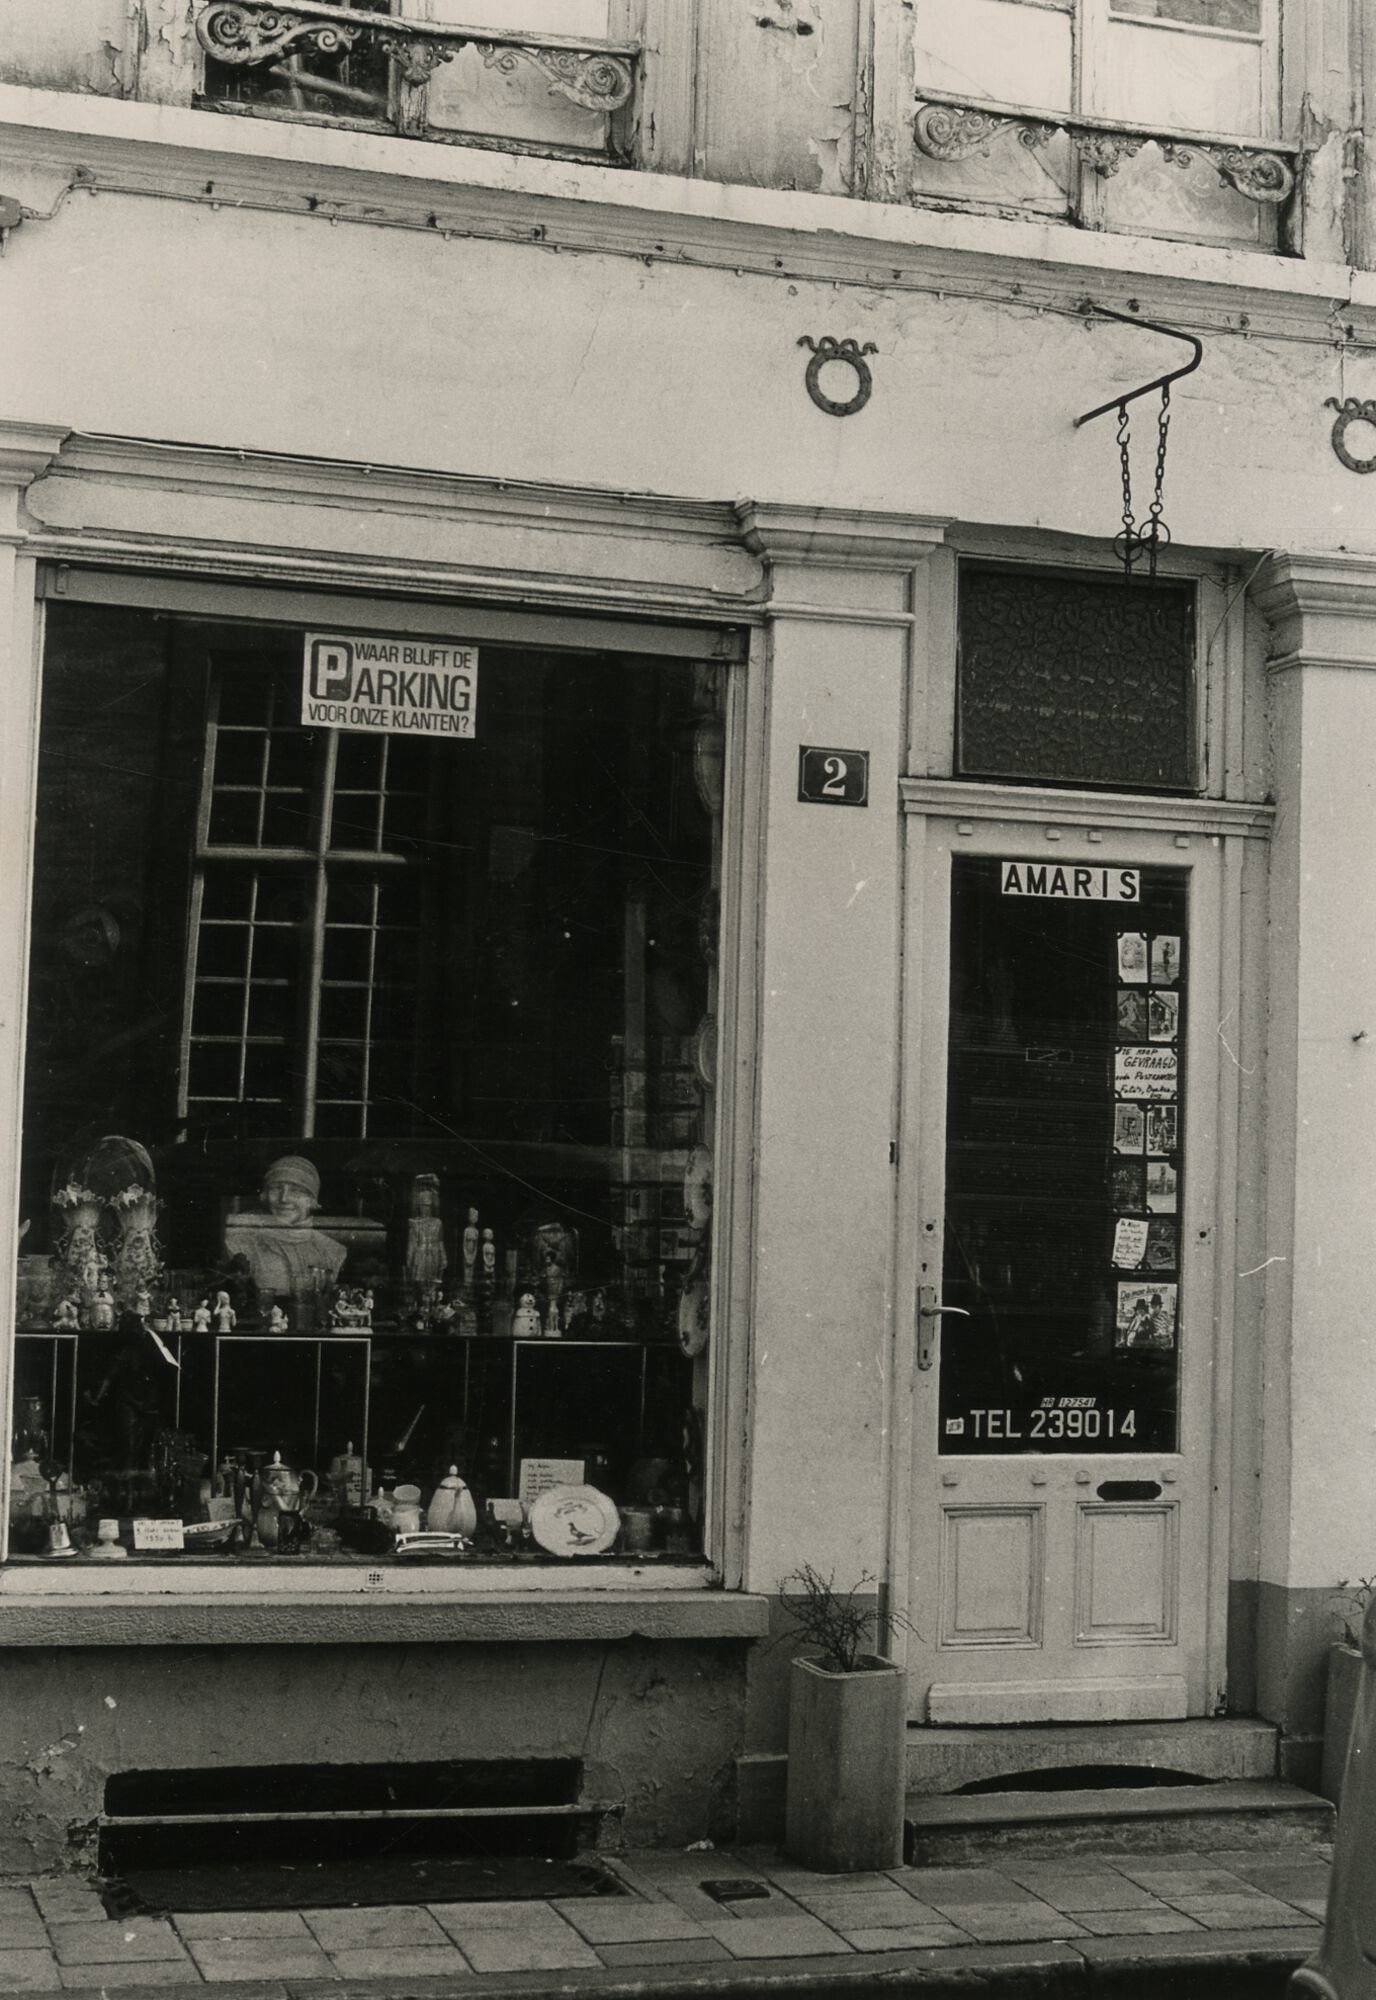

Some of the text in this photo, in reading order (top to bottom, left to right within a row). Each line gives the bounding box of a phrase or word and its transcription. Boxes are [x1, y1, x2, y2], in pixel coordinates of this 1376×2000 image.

[354, 643, 472, 669] WAAR BLIJFT DE
[308, 703, 469, 733] VOOR ONZE KLANTEN?
[822, 757, 847, 796] 2
[1003, 864, 1137, 900] AMARIS
[970, 1409, 1022, 1438] TEL
[1030, 1409, 1136, 1438] 239014
